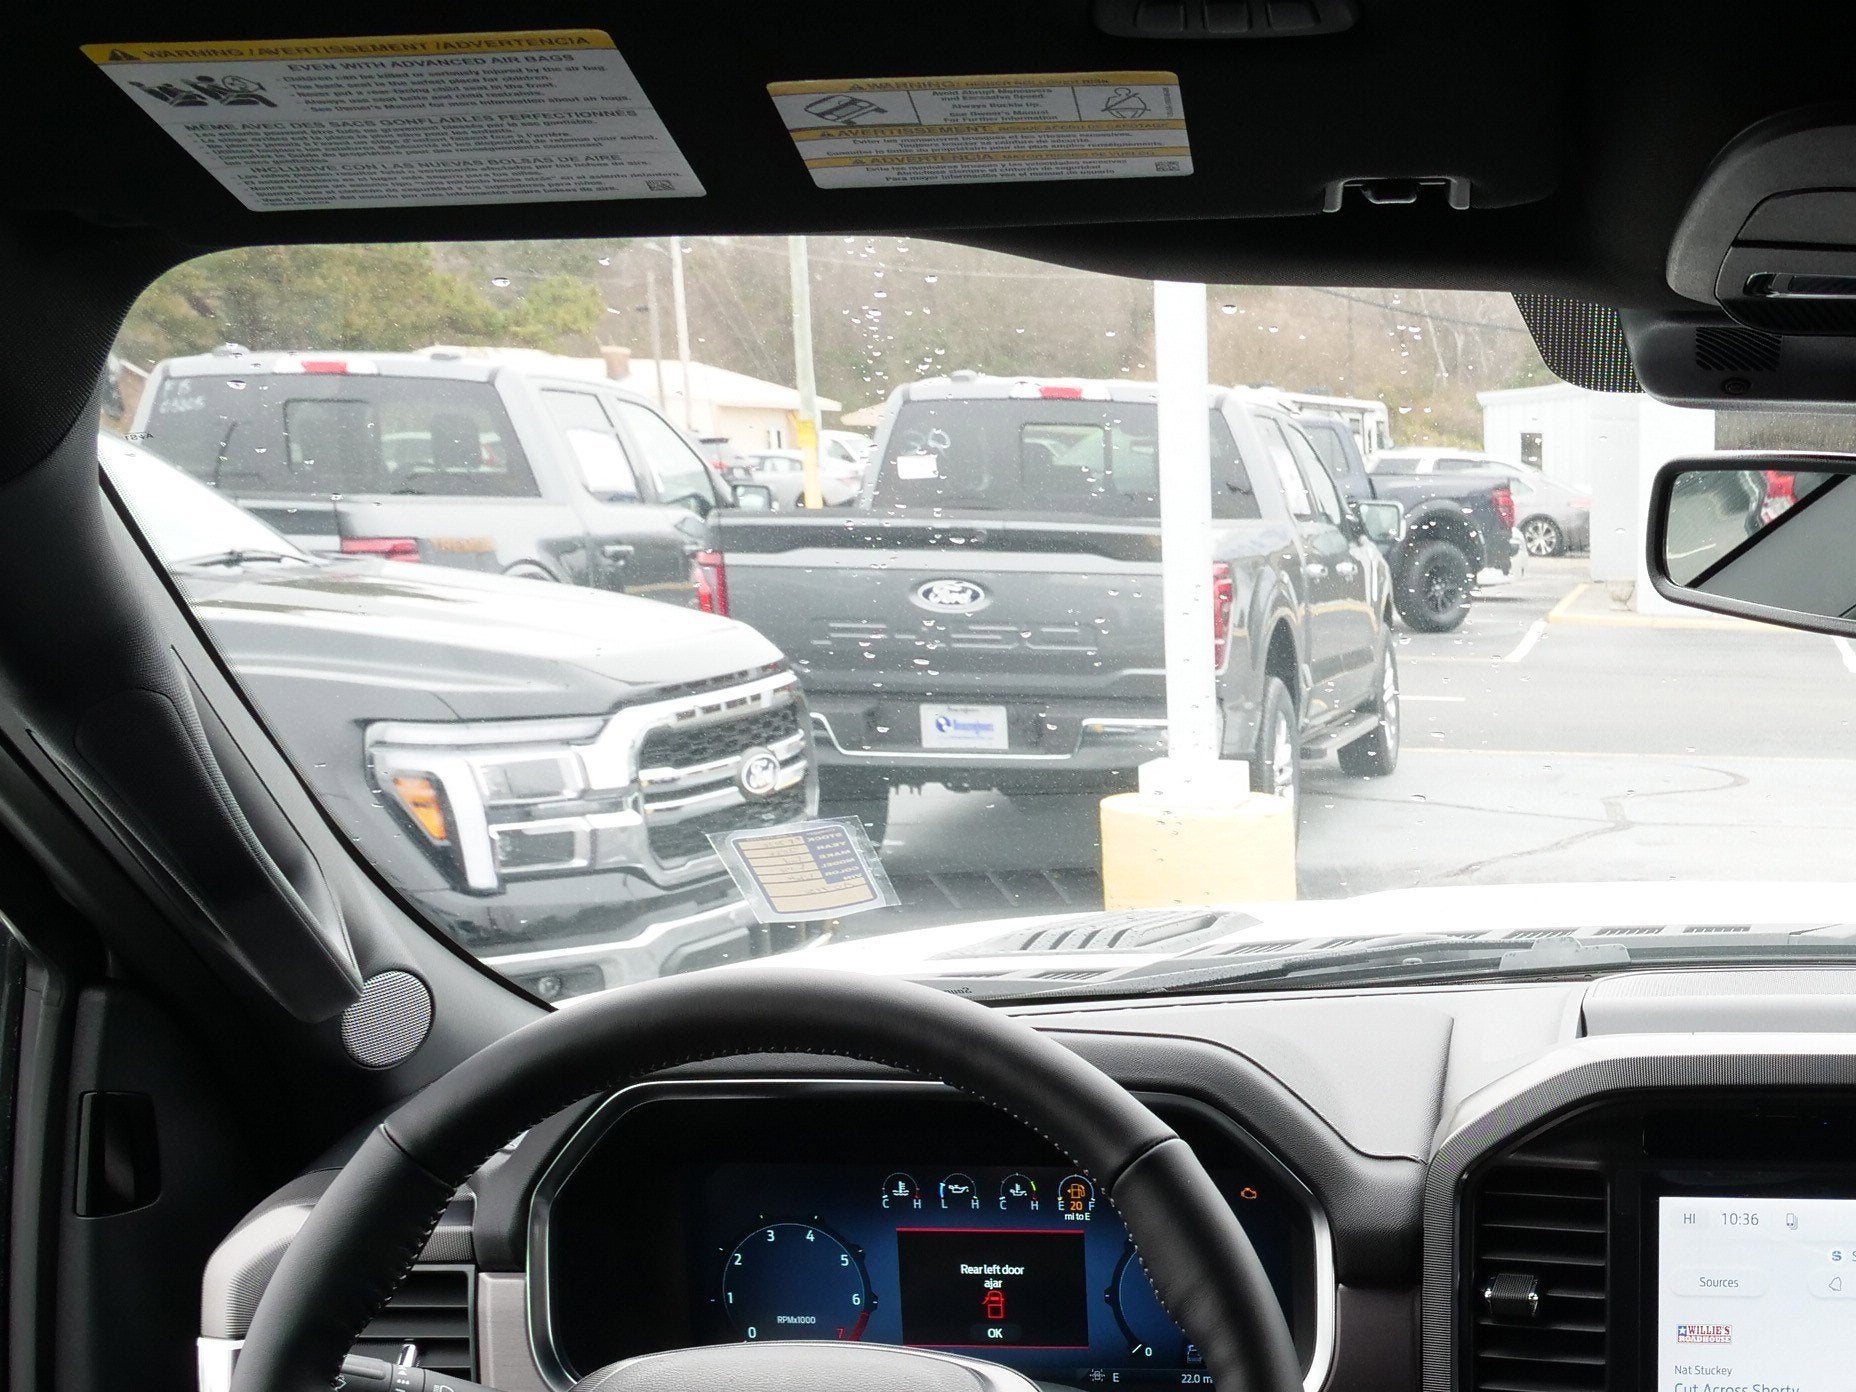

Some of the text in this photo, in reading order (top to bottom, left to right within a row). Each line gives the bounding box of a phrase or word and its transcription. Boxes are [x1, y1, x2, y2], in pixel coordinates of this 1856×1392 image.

[287, 53, 575, 72] EVEN WITH ADVANCED AIR BAGS
[240, 114, 495, 131] AVEC SACS GONFLABLES
[251, 164, 337, 173] INCLUSIVE
[929, 583, 972, 605] Ford
[1683, 1213, 1696, 1225] HI
[1721, 1212, 1760, 1227] 10:36
[766, 1229, 775, 1242] 3
[805, 1229, 815, 1242] 4
[733, 1253, 742, 1266] 2
[840, 1254, 850, 1267] 5
[960, 1263, 1025, 1275] Rear left door
[983, 1278, 1003, 1290] ajar
[1699, 1276, 1740, 1289] Sources
[727, 1292, 734, 1304] 1
[851, 1293, 861, 1306] 6
[777, 1315, 816, 1324] RPMx1000
[747, 1326, 757, 1339] 0
[836, 1327, 846, 1340] 7
[987, 1328, 1003, 1339] OK
[1687, 1324, 1731, 1336] WILLIE'S
[1677, 1335, 1732, 1344] ROADHOUSE
[1144, 1347, 1153, 1357] 0
[1112, 1372, 1120, 1383] E
[1674, 1364, 1734, 1378] Nat Stuckey
[1181, 1373, 1201, 1384] 22.0
